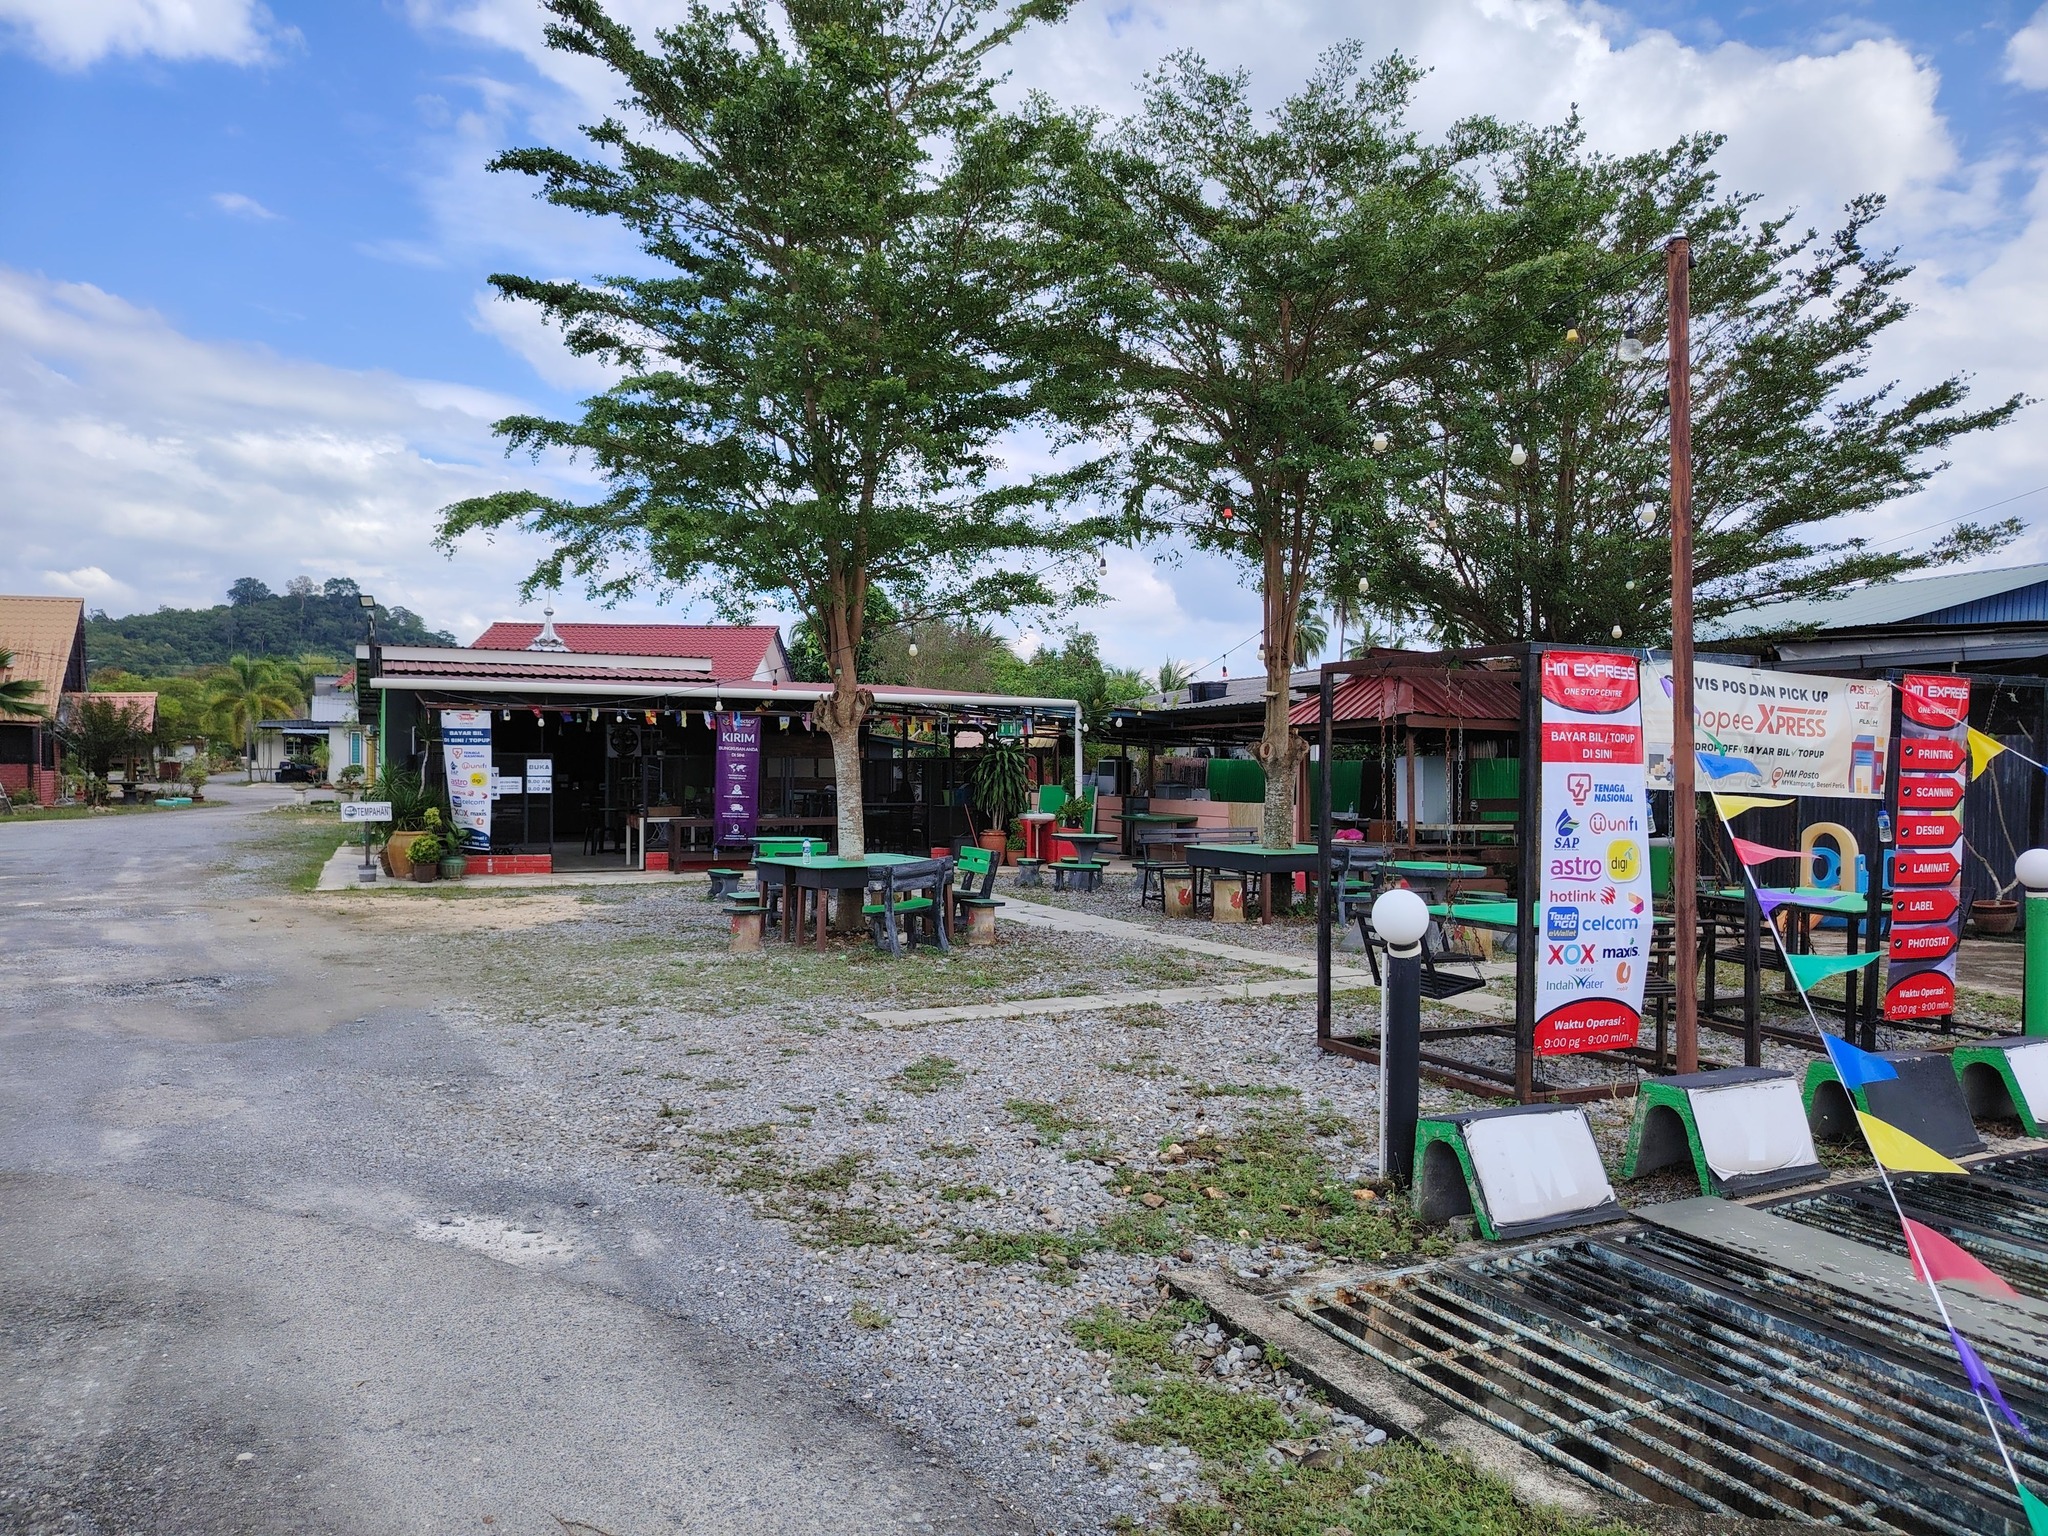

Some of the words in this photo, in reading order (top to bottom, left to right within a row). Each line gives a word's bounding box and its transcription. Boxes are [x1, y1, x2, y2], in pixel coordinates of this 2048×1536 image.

[1545, 662, 1568, 676] HM
[1574, 663, 1636, 680] EXPRESS
[1564, 687, 1579, 696] ONE
[1580, 688, 1599, 696] STOP
[1600, 689, 1622, 697] CENTRE
[1722, 680, 1746, 694] POS
[1749, 684, 1776, 698] DAN
[1779, 687, 1808, 701] PICK
[1812, 690, 1829, 702] UP
[1695, 711, 1754, 737] opee
[722, 732, 755, 743] KIRIM
[1551, 732, 1586, 742] BAYAR
[1589, 732, 1603, 742] BIL
[1605, 732, 1609, 743] /
[1610, 733, 1635, 743] TOPUP
[1582, 749, 1593, 758] DI
[1595, 749, 1612, 759] SINI
[1743, 746, 1774, 756] BAYAR
[1777, 748, 1790, 757] BIL
[1798, 749, 1824, 758] TOPUP
[1918, 749, 1953, 759] PRINTING
[1784, 770, 1797, 778] HM
[1594, 784, 1625, 793] TENAGA
[1916, 787, 1953, 797] SCANNING
[1594, 794, 1634, 802] NASIONAL
[357, 807, 390, 816] TEMPAHAN
[1608, 816, 1638, 831] unifi
[1916, 825, 1945, 835] DESIGN
[1554, 837, 1580, 848] SAP
[1550, 857, 1601, 875] astro
[1611, 857, 1627, 872] digi
[1913, 863, 1950, 873] LAMINATE
[1550, 890, 1596, 902] hotlink
[1910, 901, 1934, 911] LABEL
[1549, 912, 1578, 920] Touch
[1582, 915, 1638, 931] celcom
[1907, 936, 1950, 948] PHOTOSTAT
[1547, 944, 1596, 965] XOX
[1900, 989, 1920, 998] Waktu
[1891, 1004, 1907, 1014] 9:00
[1908, 1005, 1917, 1014] pg
[1921, 1002, 1936, 1011] 9:00
[1554, 1020, 1584, 1030] Waktu
[1544, 1037, 1566, 1048] 9:00
[1568, 1037, 1580, 1049] pg
[1588, 1034, 1608, 1045] 9:00
